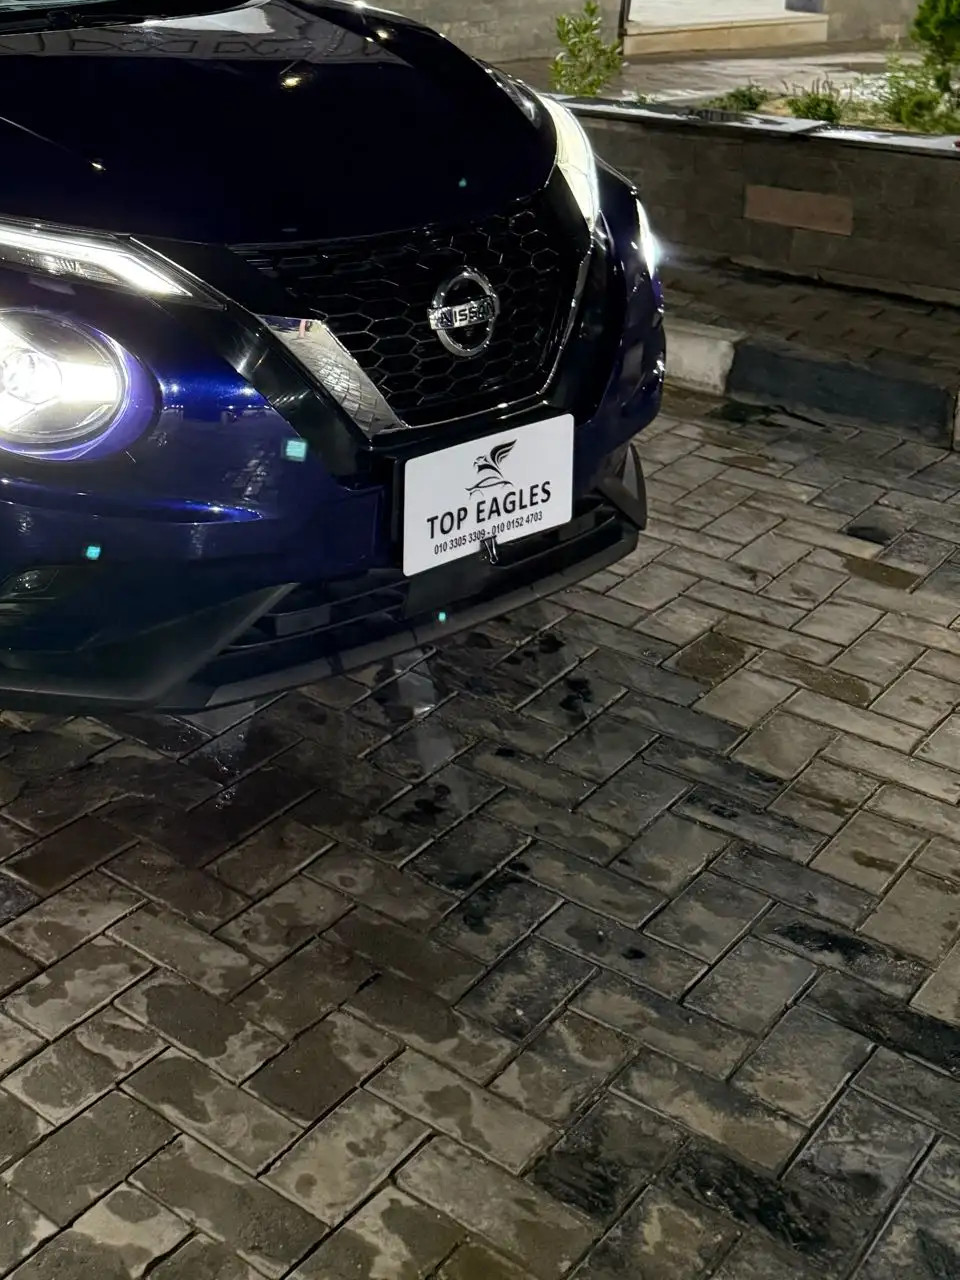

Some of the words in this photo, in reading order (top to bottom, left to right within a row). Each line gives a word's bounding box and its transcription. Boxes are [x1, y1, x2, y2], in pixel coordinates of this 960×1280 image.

[427, 506, 468, 539] TOP
[476, 480, 551, 523] EAGLES
[434, 542, 448, 555] 010
[449, 535, 467, 550] 3305
[468, 529, 486, 543] 3309
[491, 522, 505, 536] 010
[506, 516, 524, 531] 0152
